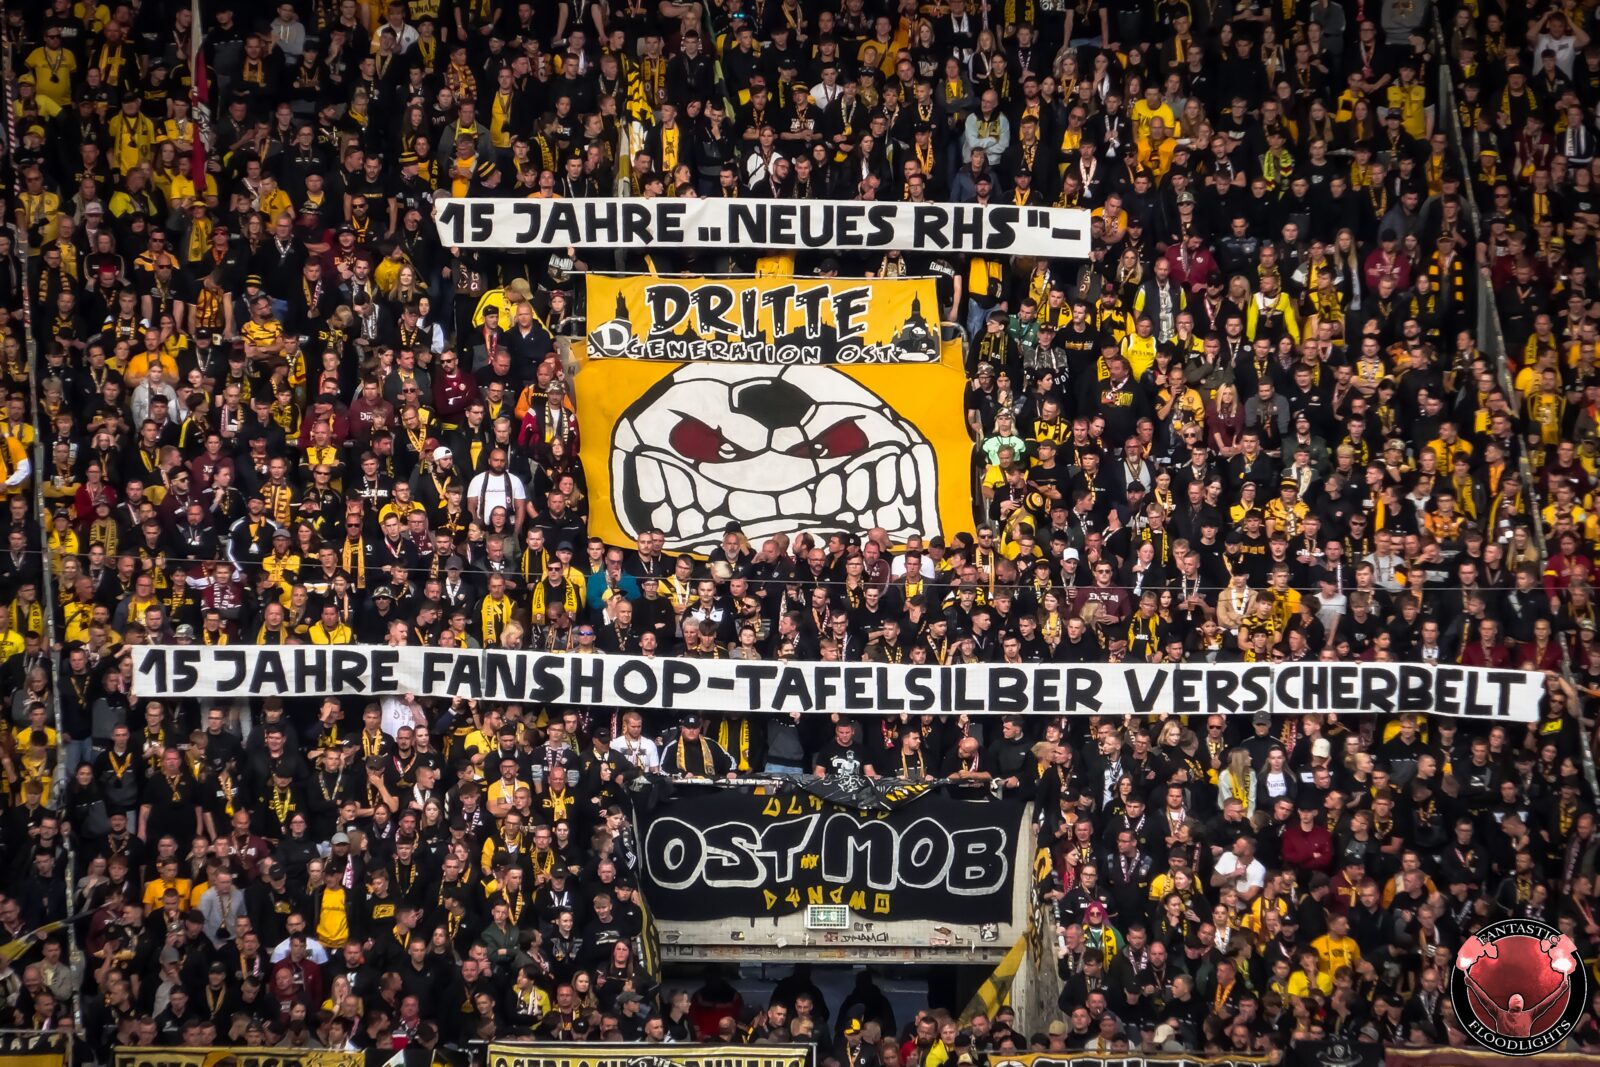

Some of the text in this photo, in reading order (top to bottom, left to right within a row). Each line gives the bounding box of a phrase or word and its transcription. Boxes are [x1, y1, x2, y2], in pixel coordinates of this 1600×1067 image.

[439, 202, 495, 244] 15
[513, 202, 687, 245] JAHRE
[645, 283, 873, 342] DRITTE
[625, 338, 822, 365] GENERATION
[138, 648, 201, 693] 15
[214, 650, 399, 694] JAHRE
[1124, 665, 1527, 721] VERSCHERBELT
